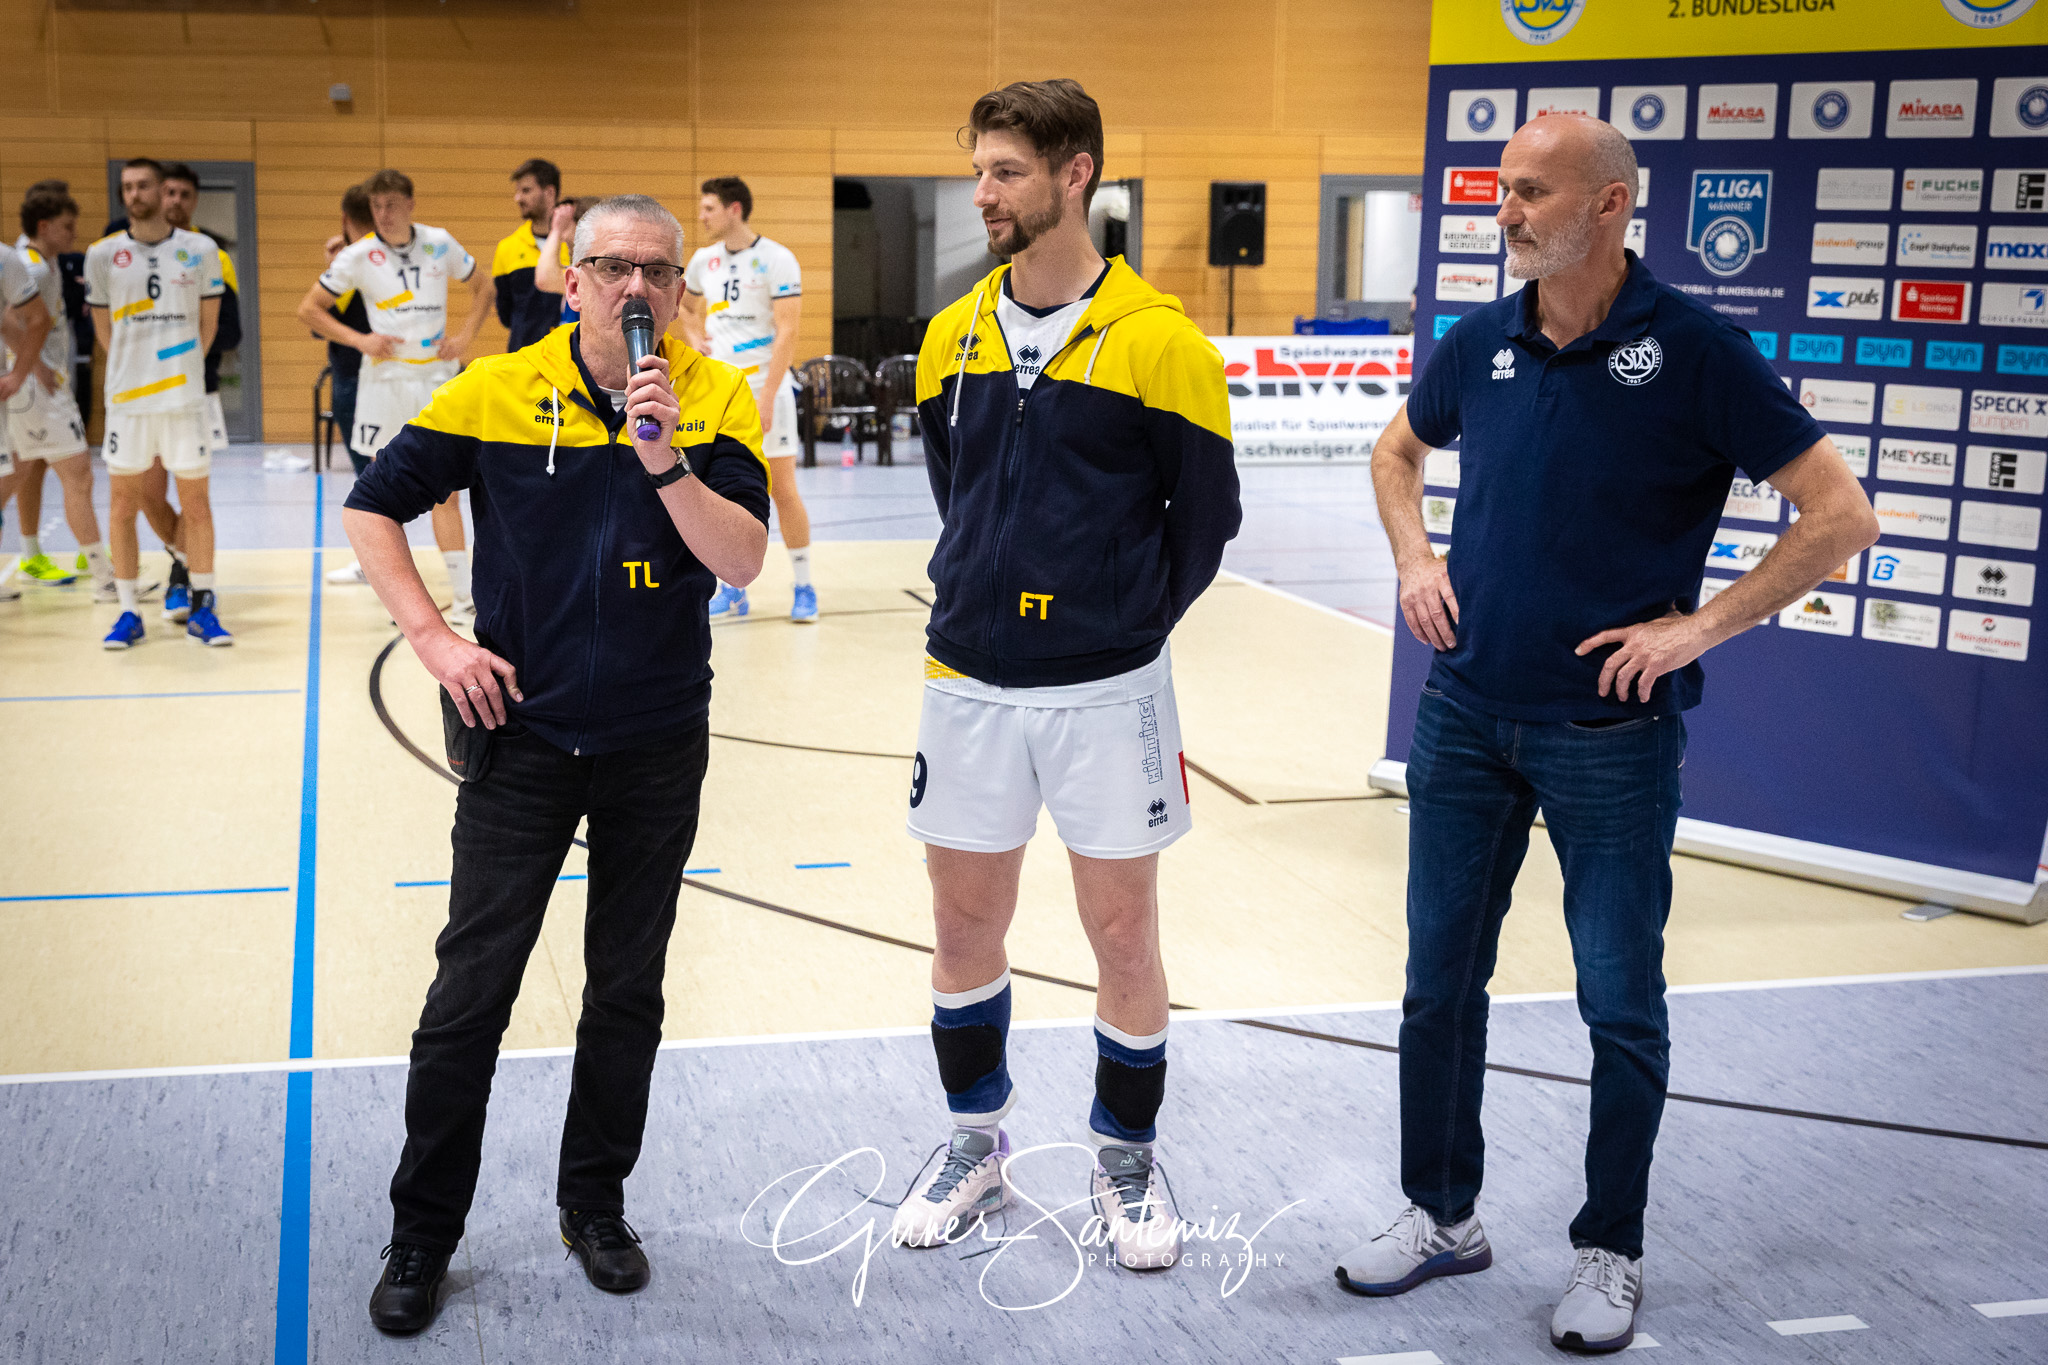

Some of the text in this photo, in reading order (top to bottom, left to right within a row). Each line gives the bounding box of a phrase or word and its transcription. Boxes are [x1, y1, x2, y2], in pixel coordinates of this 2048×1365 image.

[1668, 0, 1836, 18] 2. BUNDESLIGA
[1921, 179, 1979, 191] FUCHS
[1988, 243, 2048, 258] max
[148, 274, 161, 300] 6
[398, 267, 420, 290] 17
[723, 279, 740, 301] 15
[955, 351, 978, 361] erea
[1279, 345, 1393, 358] Spielwaren
[1974, 395, 2029, 414] SPECK
[1970, 413, 2029, 431] pumpen
[360, 424, 380, 446] 17
[1237, 439, 1372, 458] .schweiger.d
[1882, 448, 1952, 467] MEYSEL
[622, 561, 660, 589] TL
[1019, 591, 1054, 620] FT
[910, 751, 928, 808] 9
